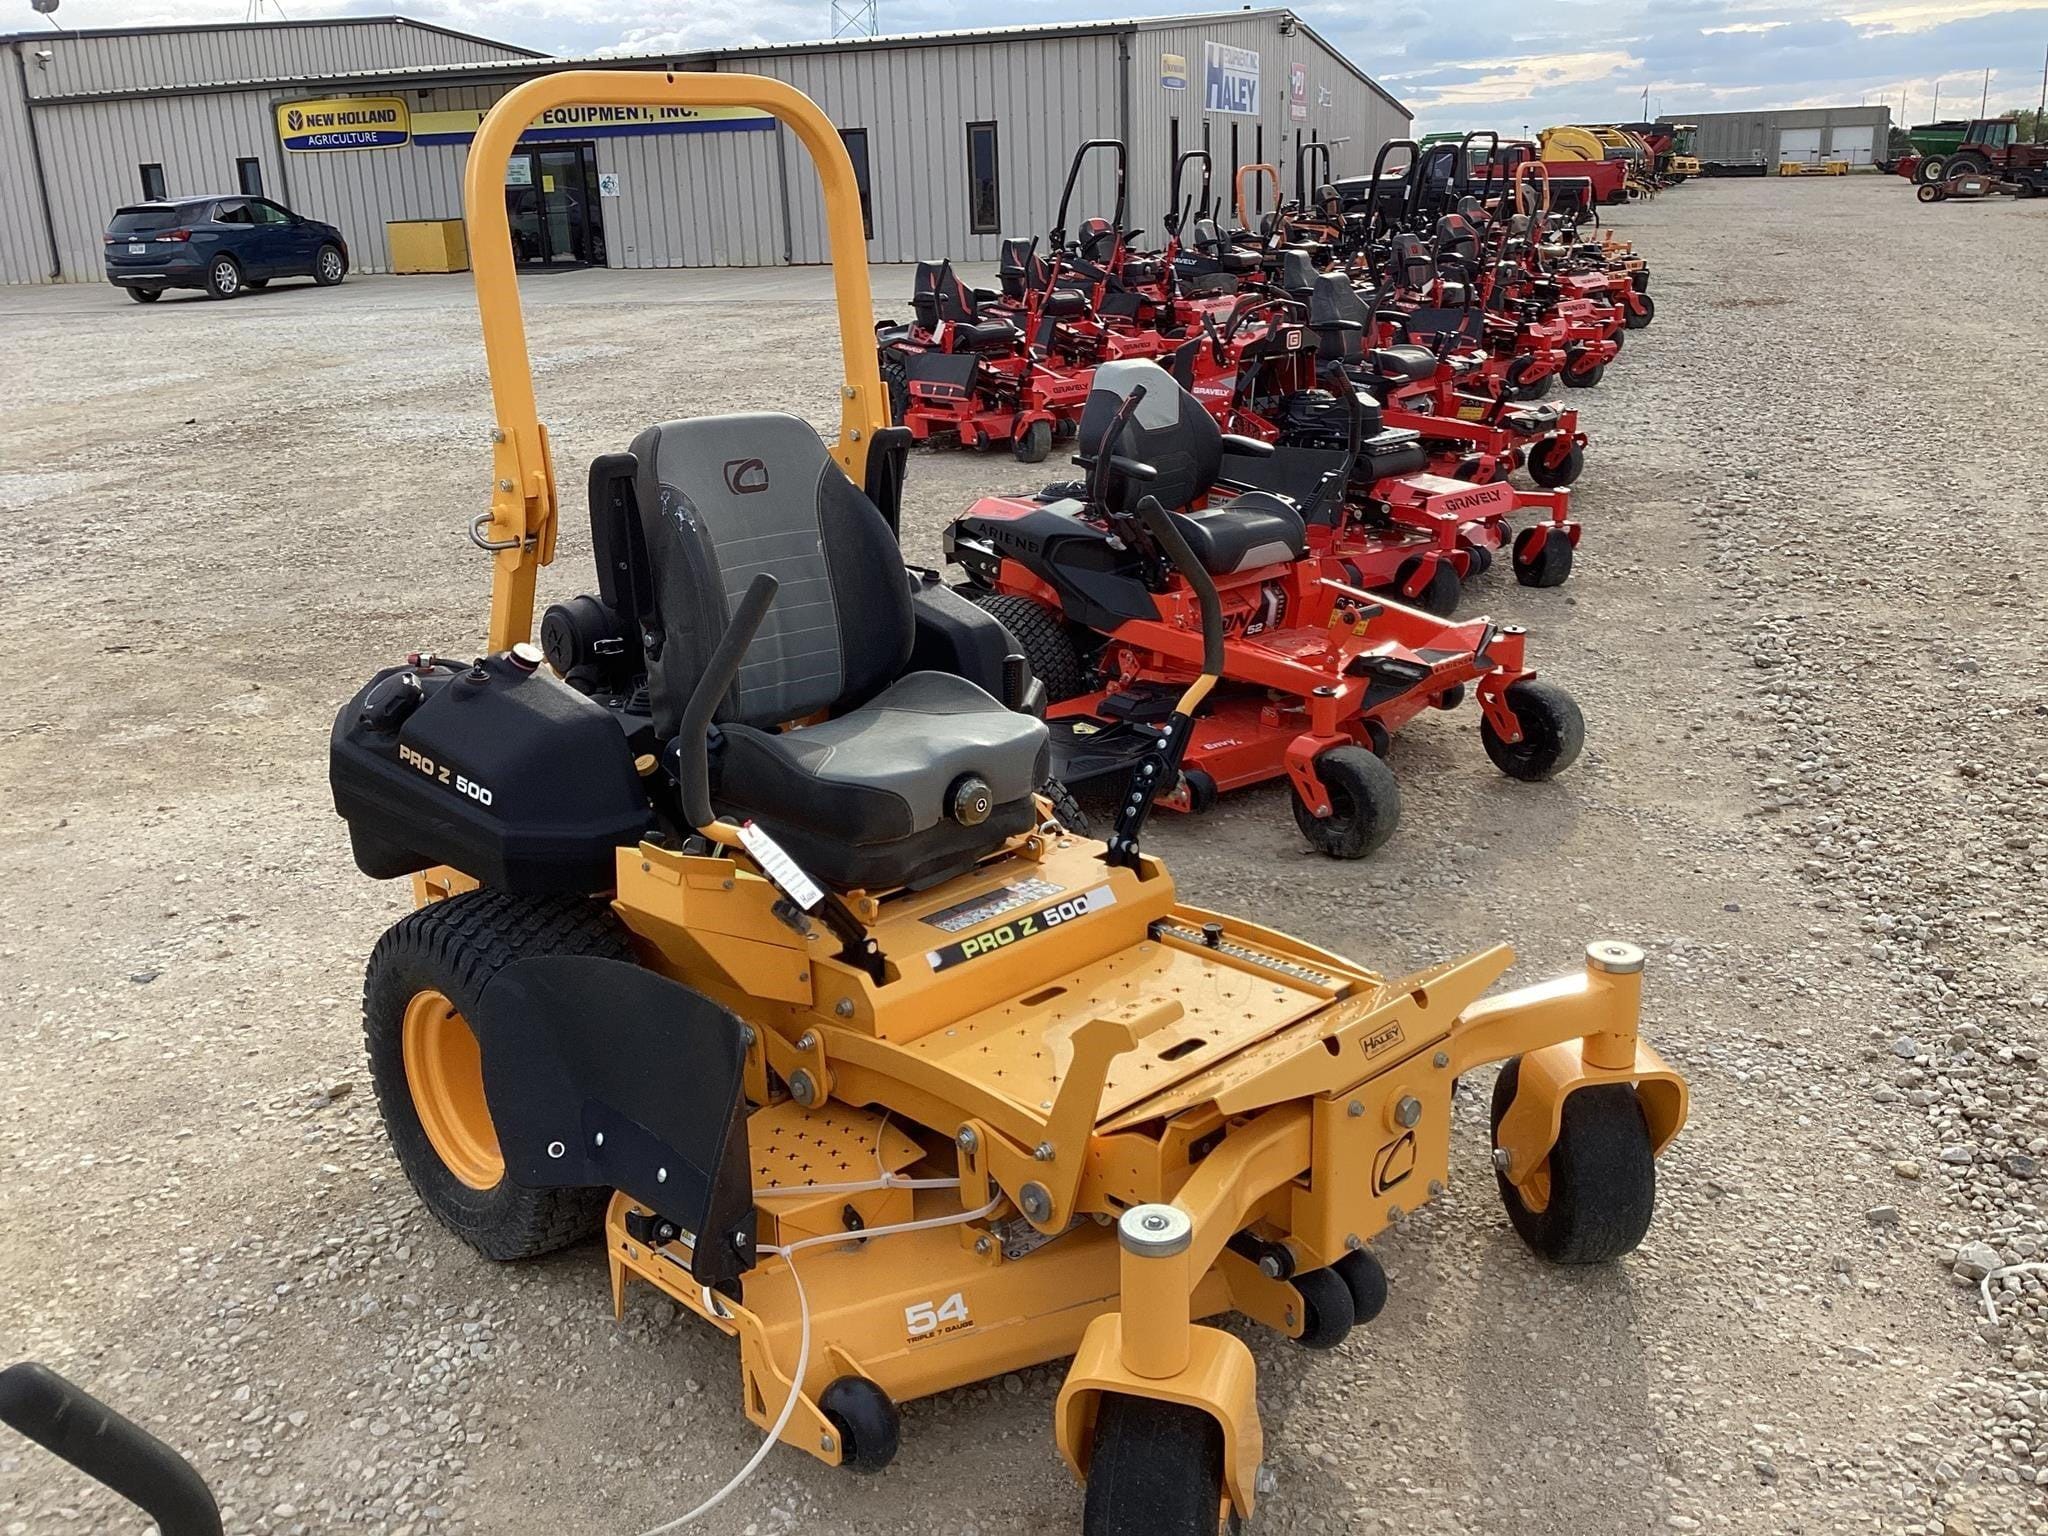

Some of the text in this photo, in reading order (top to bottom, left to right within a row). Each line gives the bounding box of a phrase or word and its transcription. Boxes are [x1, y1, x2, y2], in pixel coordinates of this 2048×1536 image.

[1206, 45, 1257, 113] HALEY
[306, 109, 396, 127] NEW HOLLAND
[308, 132, 378, 146] AGRICULTURE
[1172, 256, 1198, 266] AVELY
[1053, 383, 1089, 394] GRAVELY
[1193, 386, 1230, 397] GRAVELY
[1445, 490, 1502, 511] GRAVELY
[1247, 622, 1264, 635] 52
[400, 744, 493, 806] PRO Z 500
[961, 925, 1015, 959] PRO
[1018, 916, 1038, 937] Z
[1043, 896, 1088, 926] 500
[1363, 1027, 1399, 1053] HALEY
[905, 1292, 969, 1335] 54
[906, 1331, 935, 1344] TRIPLE
[945, 1320, 974, 1333] GAUGE
